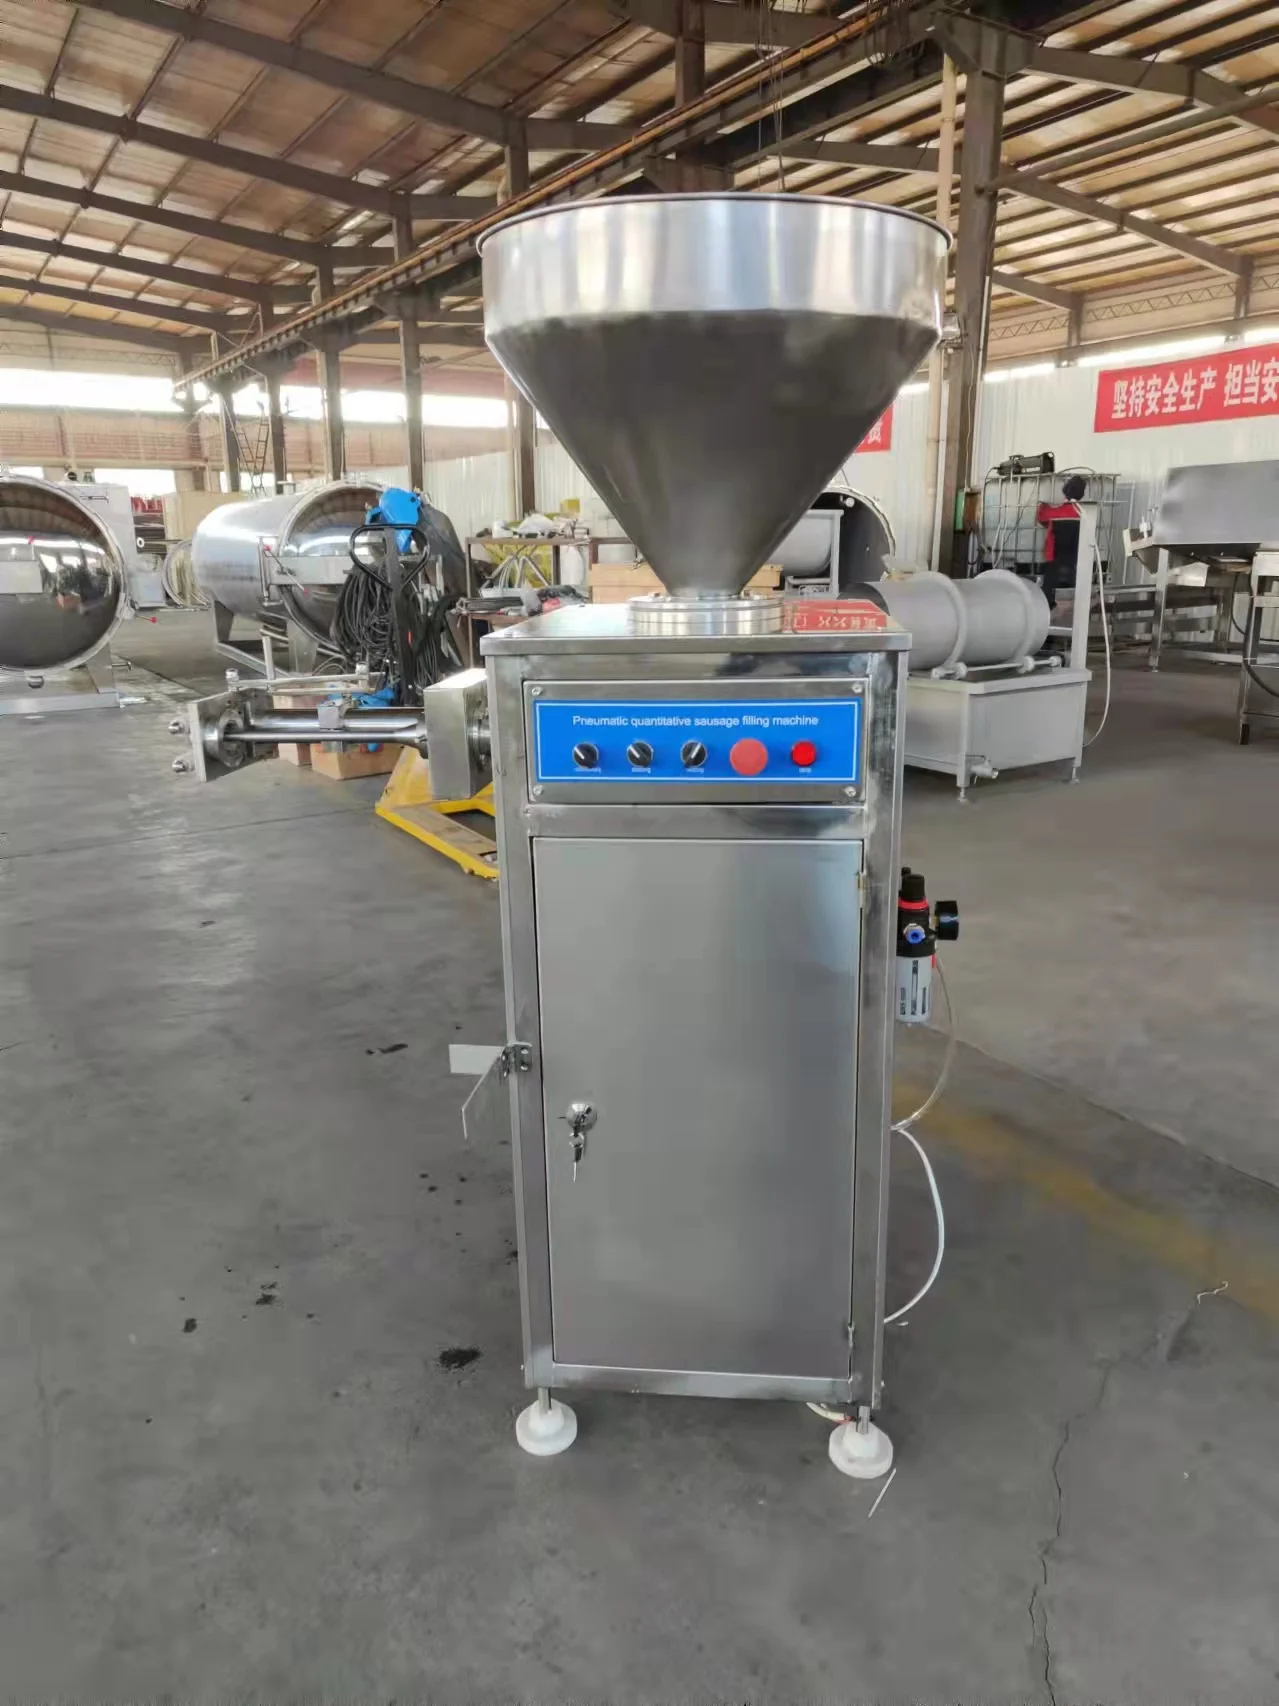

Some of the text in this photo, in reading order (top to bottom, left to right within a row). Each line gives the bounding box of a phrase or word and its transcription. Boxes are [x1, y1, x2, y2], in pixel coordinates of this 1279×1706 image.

[1111, 366, 1217, 419] 坚持安全生产
[572, 715, 819, 729] Pneumatic quantitative sausage filling machine
